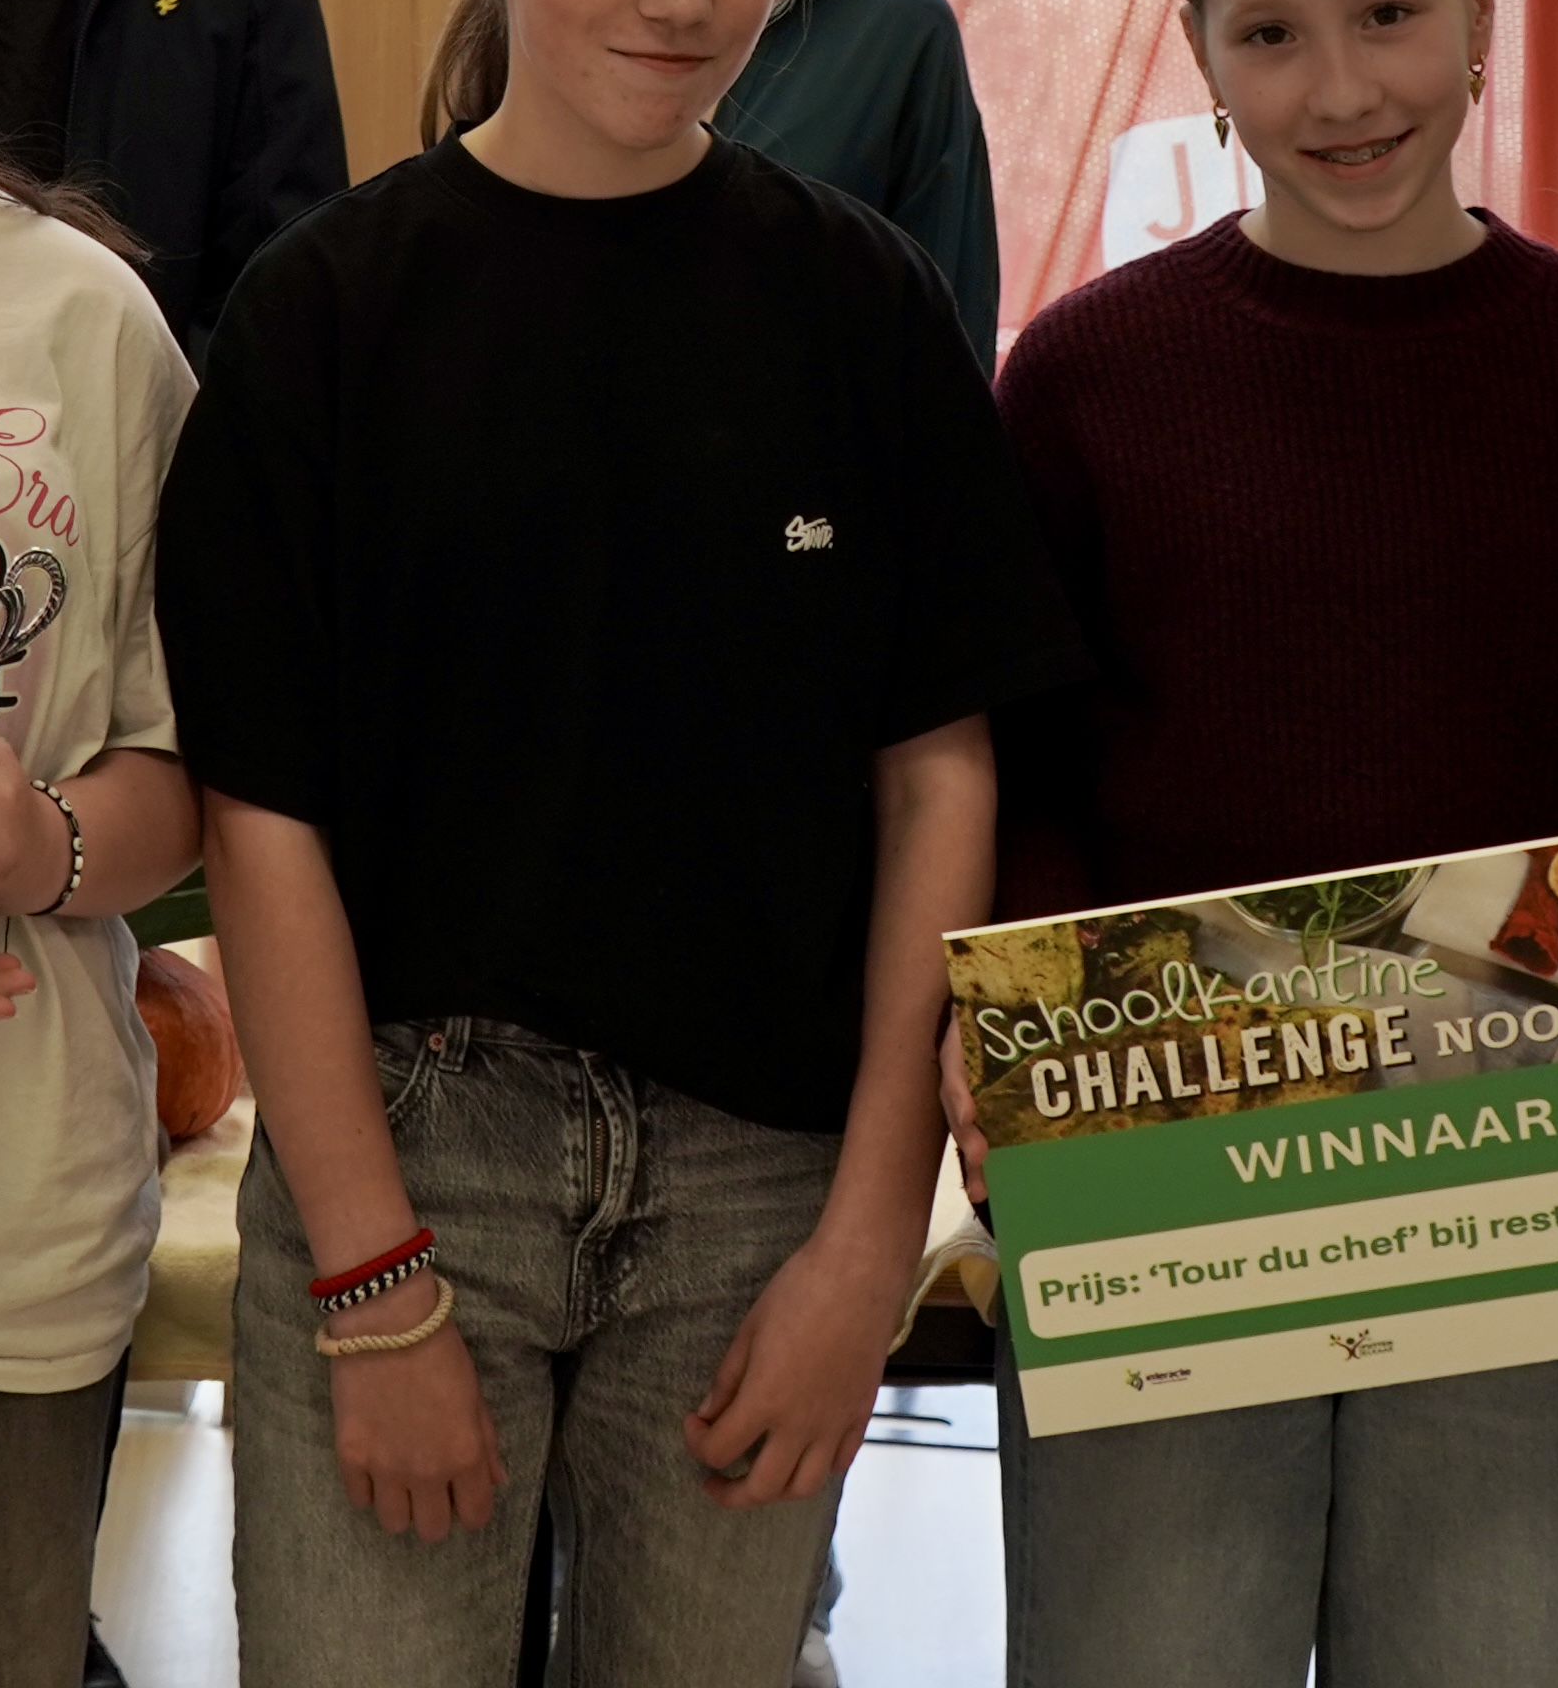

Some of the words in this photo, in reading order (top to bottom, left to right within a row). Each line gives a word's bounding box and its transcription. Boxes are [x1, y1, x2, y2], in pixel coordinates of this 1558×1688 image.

[976, 940, 1446, 1062] Schoolkantine
[1031, 1005, 1414, 1119] CHALLENGE
[1225, 1098, 1557, 1184] WINNAAR
[1039, 1272, 1141, 1307] Prijs:
[1258, 1245, 1309, 1274] du
[1430, 1215, 1477, 1250] bij
